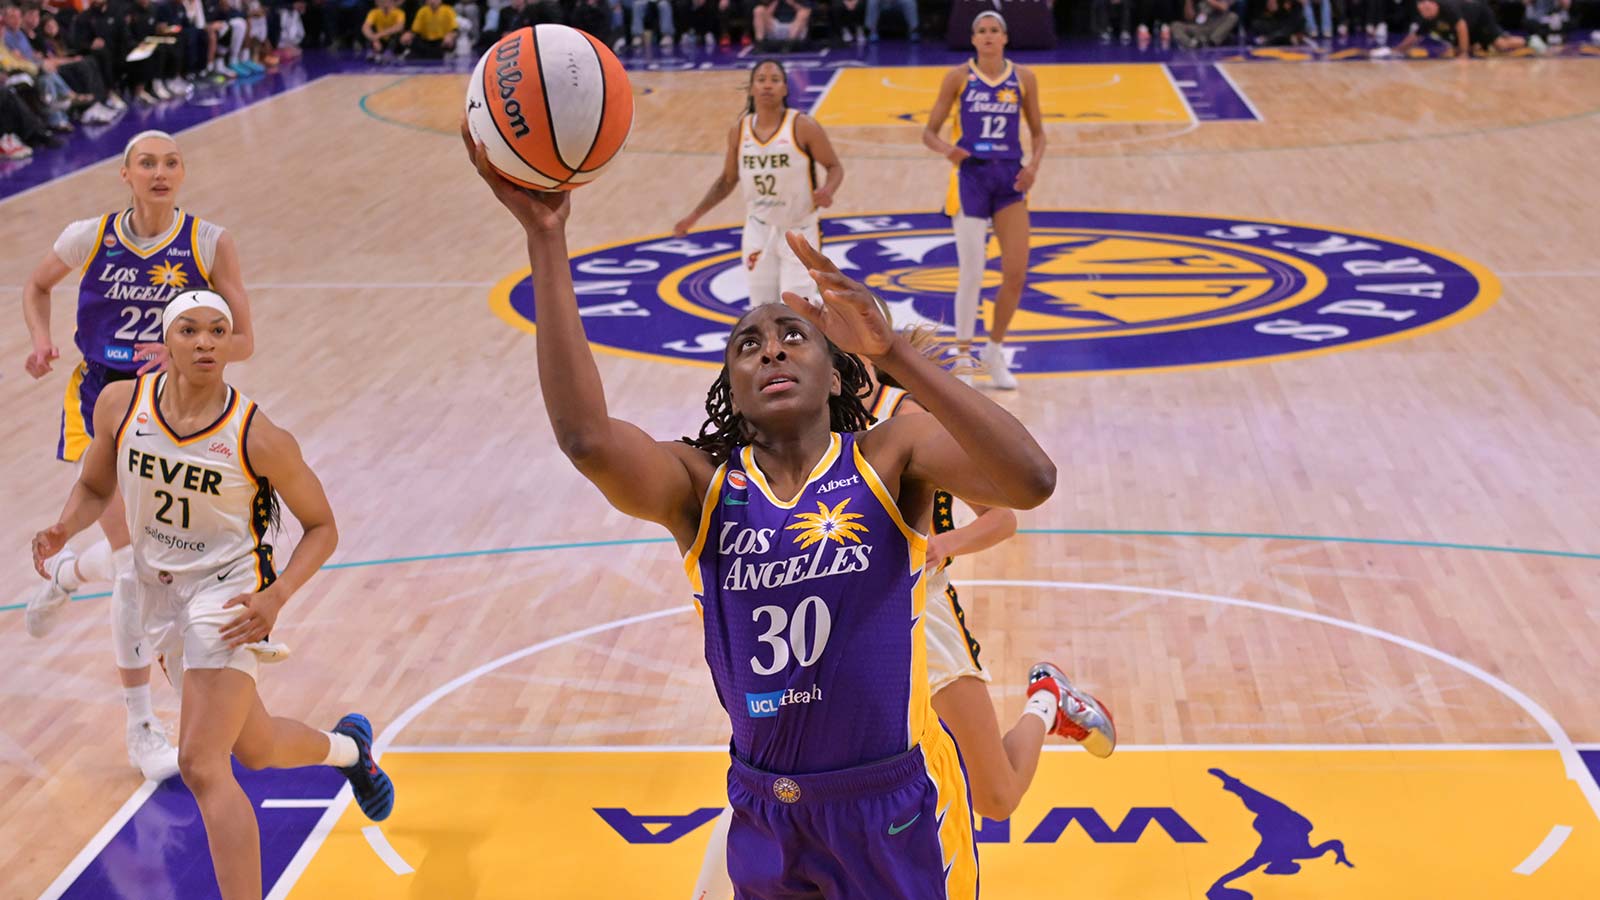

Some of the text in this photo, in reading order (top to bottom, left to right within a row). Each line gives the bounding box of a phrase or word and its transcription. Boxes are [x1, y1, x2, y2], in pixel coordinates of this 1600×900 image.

[495, 34, 530, 139] Wilson
[980, 115, 1008, 139] 12
[743, 154, 790, 169] FEVER
[754, 174, 777, 196] 52
[166, 248, 191, 257] Albert
[98, 263, 139, 283] LOS
[104, 281, 184, 302] ANGELE
[114, 306, 163, 341] 22
[107, 350, 129, 360] UCLA
[208, 441, 233, 458] Lilly
[128, 448, 222, 496] FEVER
[817, 474, 860, 494] Albert
[154, 489, 190, 529] 21
[145, 526, 205, 552] salesforce
[719, 521, 776, 555] LOS
[723, 533, 873, 591] ANGELES
[750, 596, 832, 676] 30
[750, 700, 779, 714] UCL
